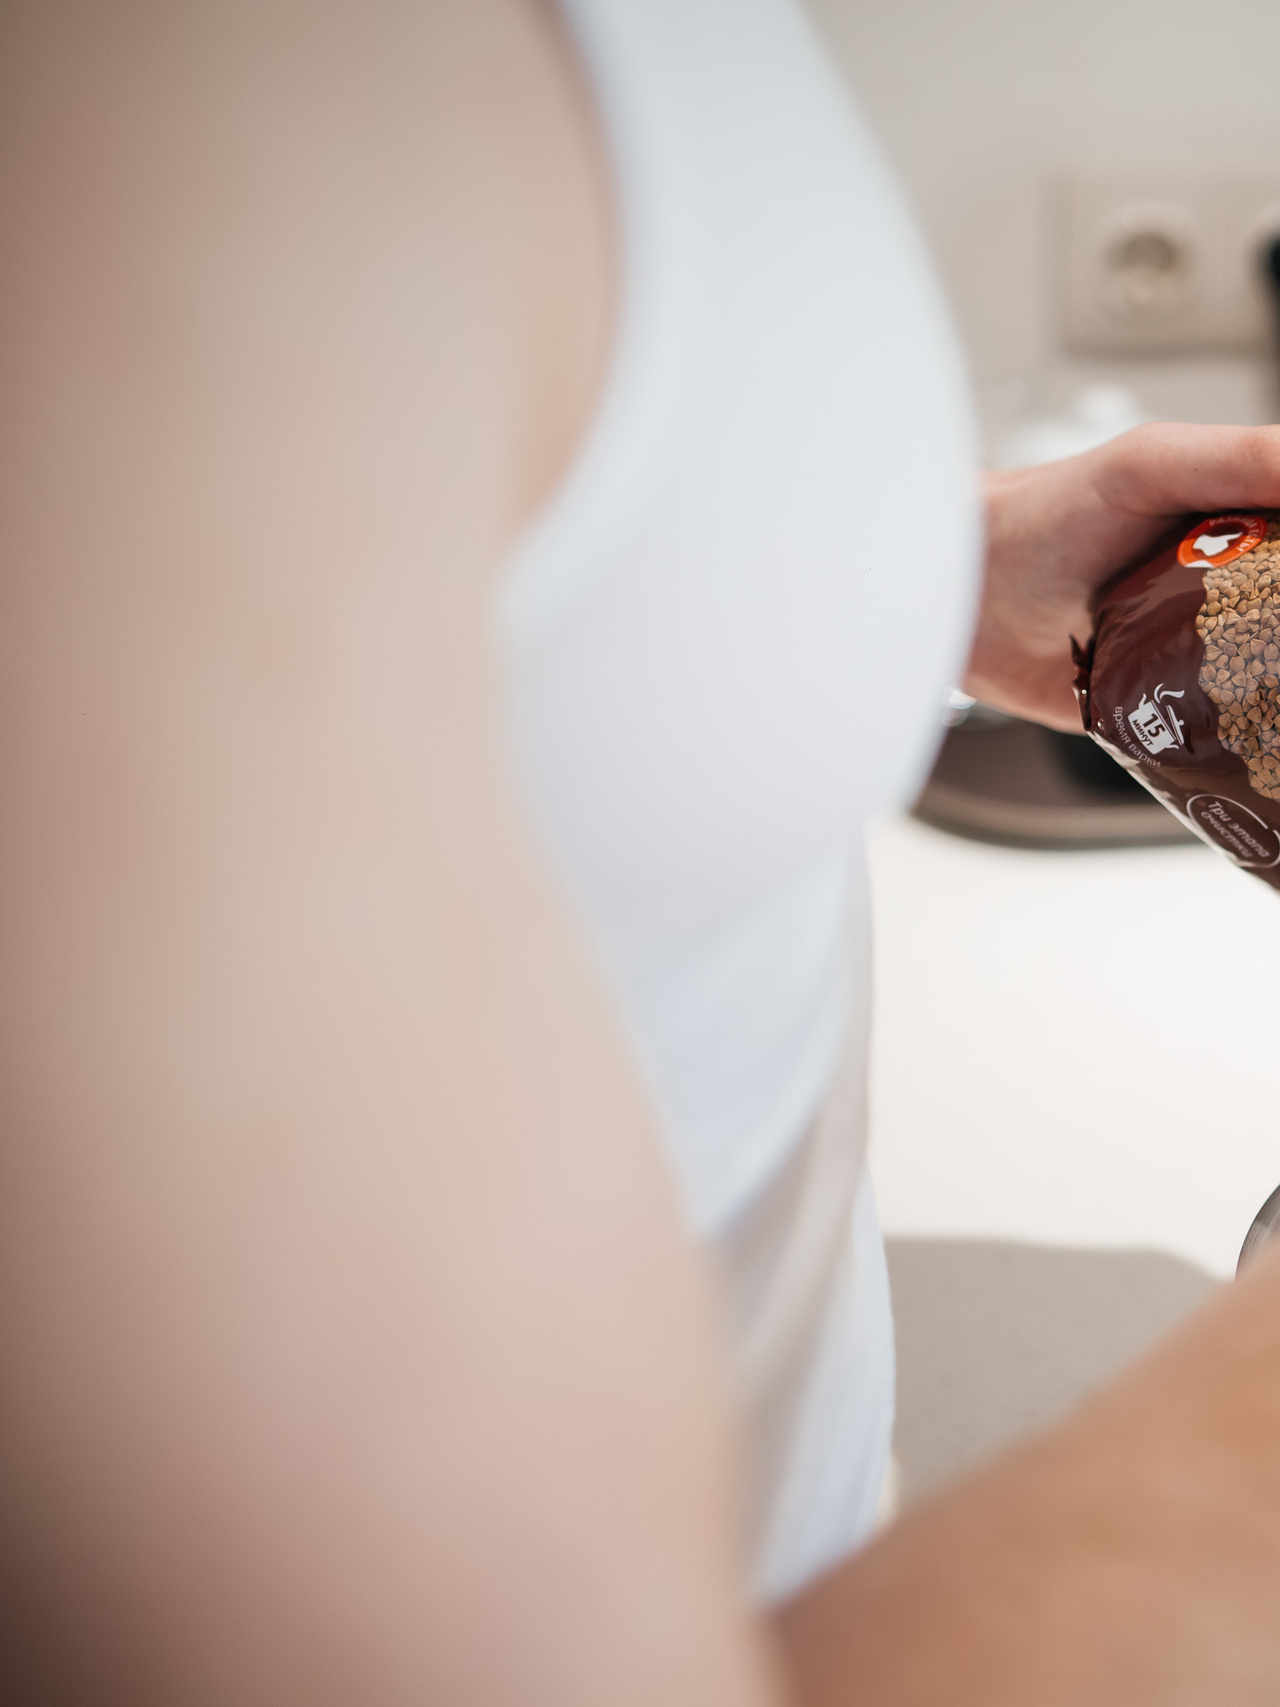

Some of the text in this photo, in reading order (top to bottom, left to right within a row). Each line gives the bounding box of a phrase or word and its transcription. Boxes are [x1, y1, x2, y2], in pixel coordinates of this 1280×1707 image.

[1112, 706, 1161, 768] время варки
[1131, 719, 1154, 747] минут
[1142, 712, 1166, 738] 15
[1208, 800, 1270, 858] Три этапа
